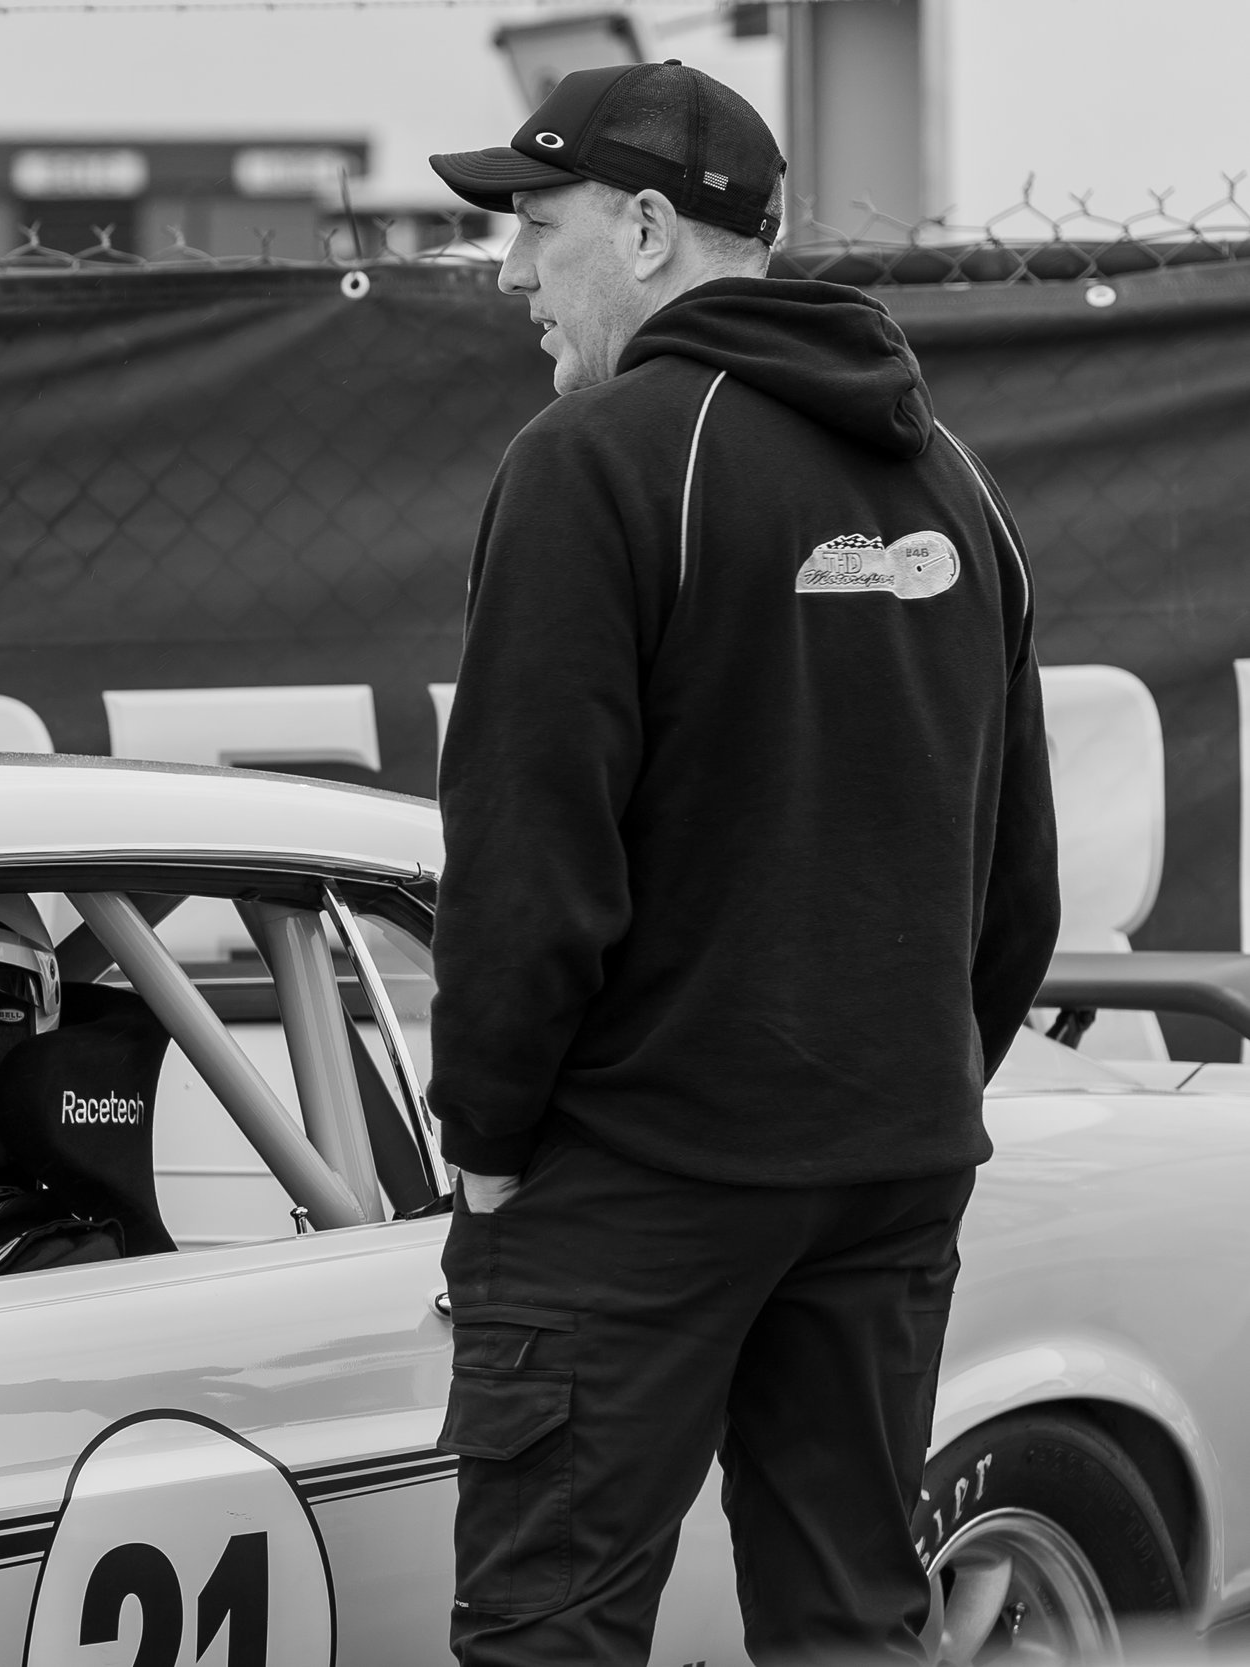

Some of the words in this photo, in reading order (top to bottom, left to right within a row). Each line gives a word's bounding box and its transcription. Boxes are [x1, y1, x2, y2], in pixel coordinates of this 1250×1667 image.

[822, 551, 863, 575] THD
[61, 1090, 145, 1125] Racetech
[79, 1530, 269, 1667] 21
